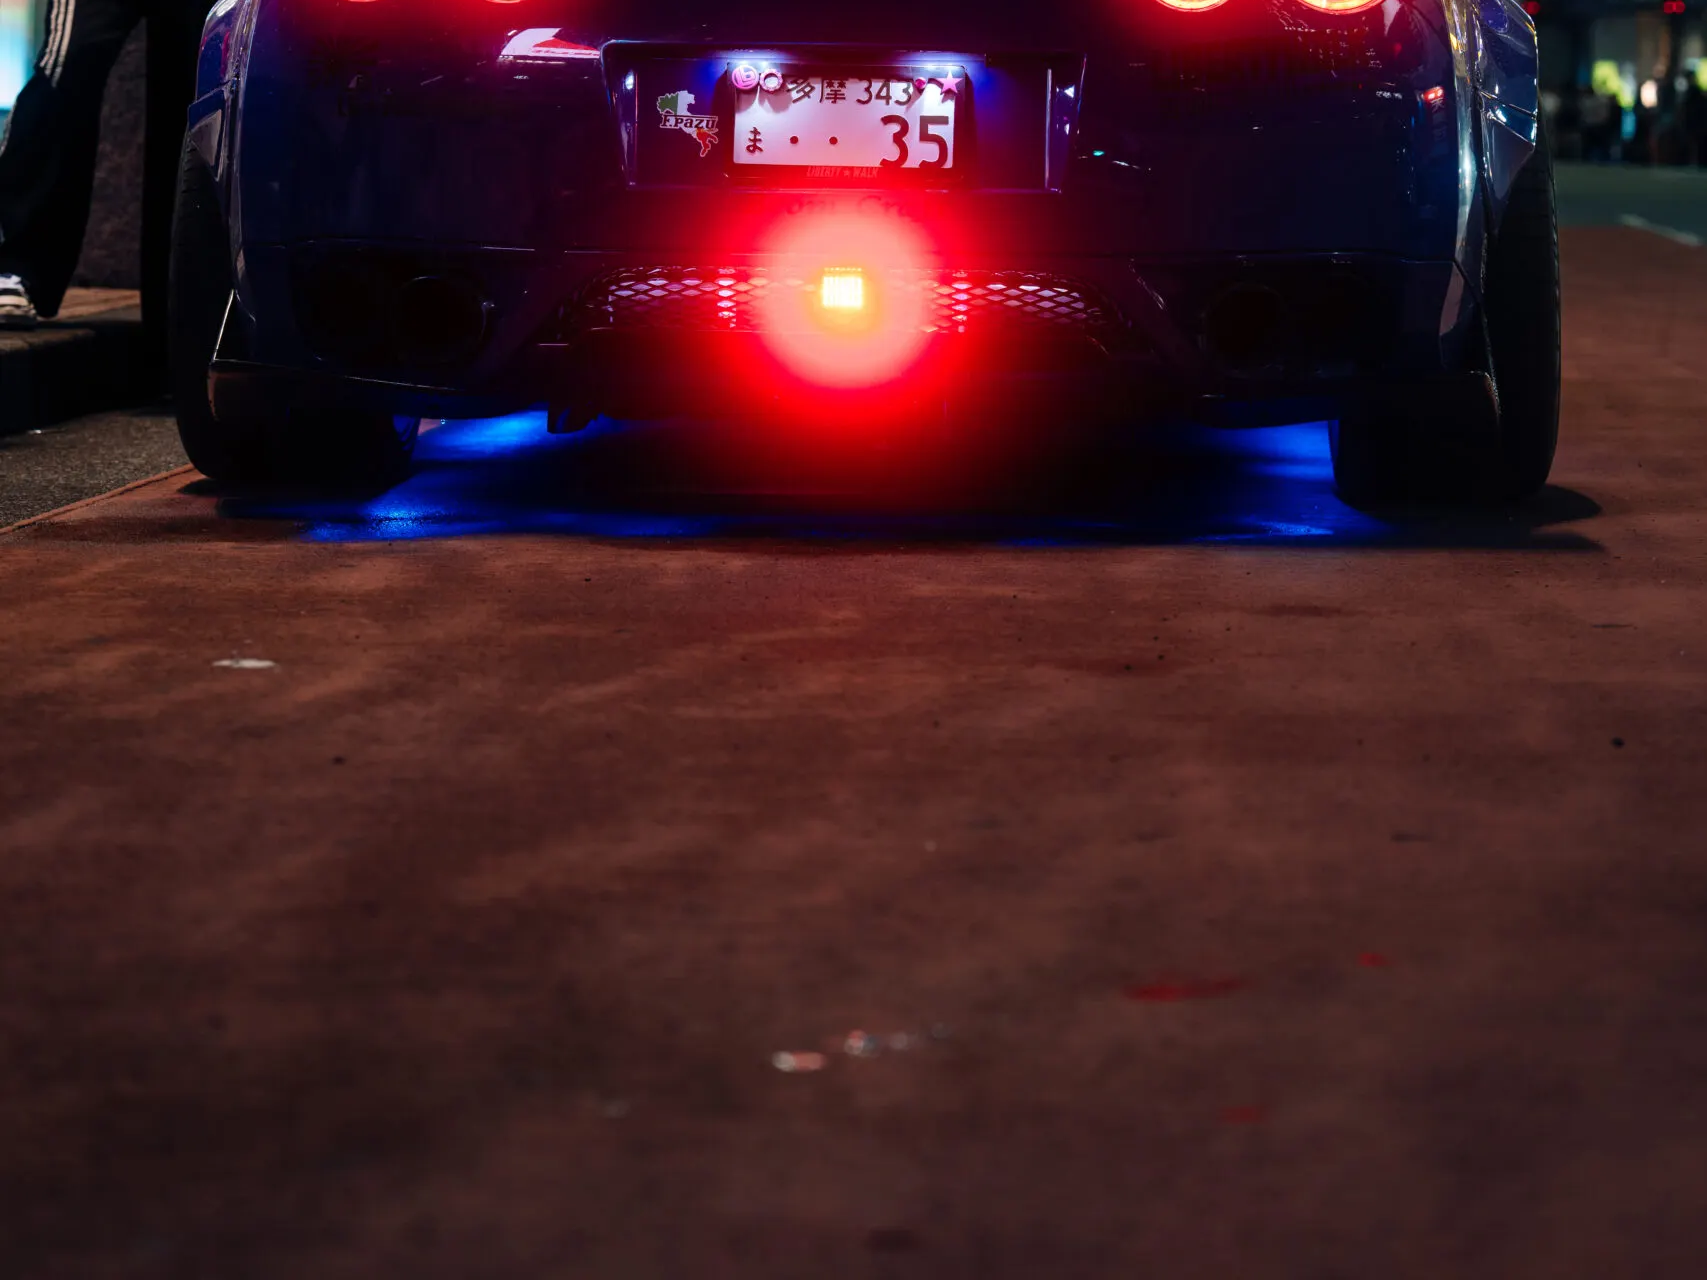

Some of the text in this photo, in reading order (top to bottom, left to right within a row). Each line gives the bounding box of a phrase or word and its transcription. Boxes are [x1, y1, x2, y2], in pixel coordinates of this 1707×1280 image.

[786, 78, 913, 107] 多摩 343
[745, 114, 950, 169] ま 35
